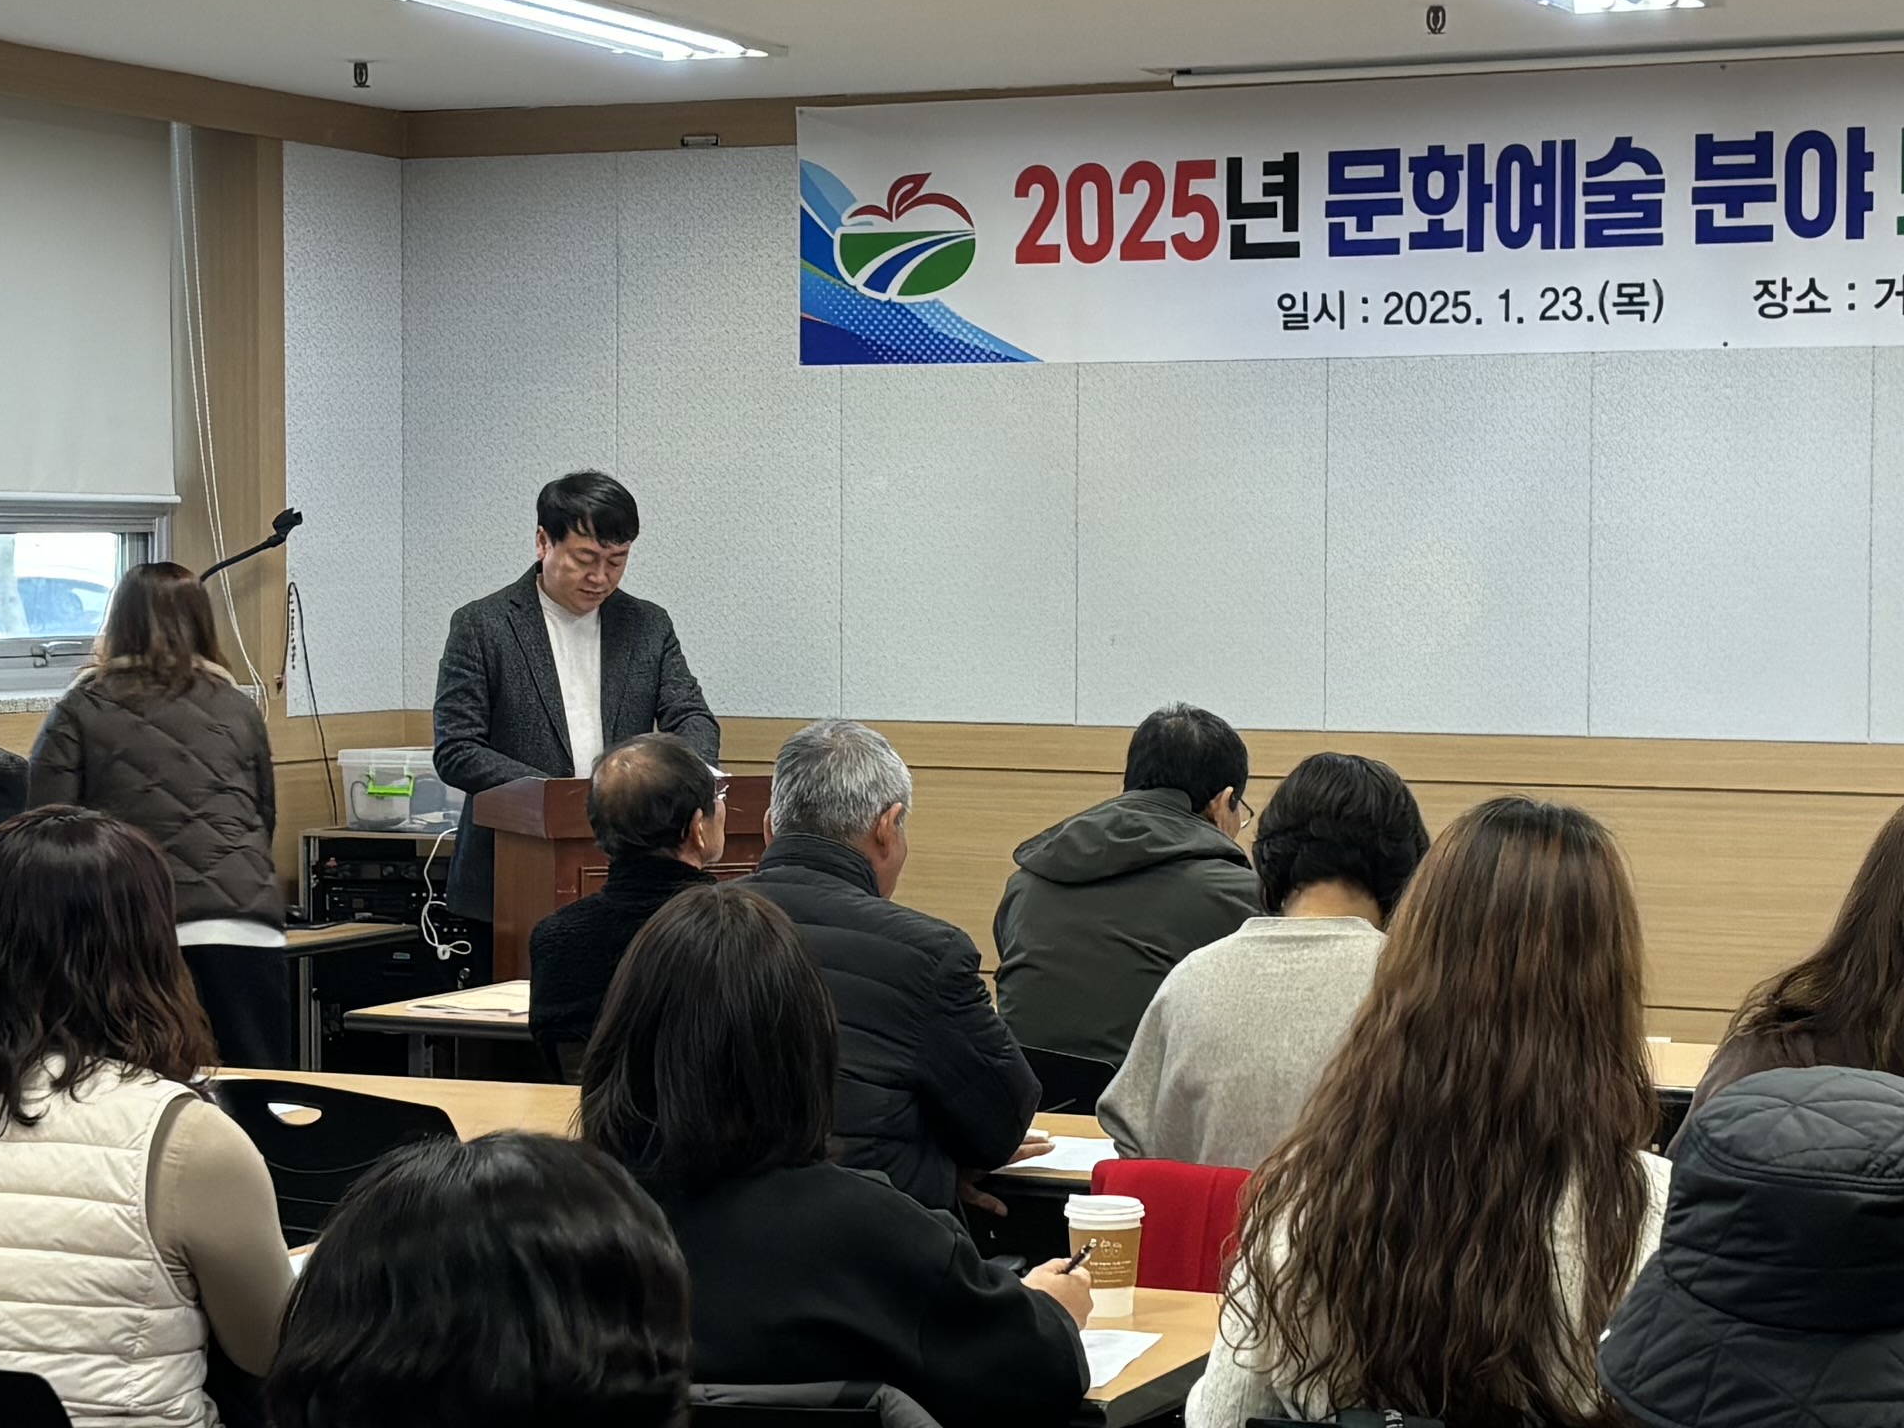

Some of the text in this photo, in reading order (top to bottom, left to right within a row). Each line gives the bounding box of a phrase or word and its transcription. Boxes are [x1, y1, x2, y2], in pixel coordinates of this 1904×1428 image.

[1013, 151, 1301, 266] 2025년
[1323, 136, 1666, 259] 문화예술
[1691, 126, 1875, 245] 분야
[1275, 290, 1346, 331] 일시
[1382, 290, 1484, 327] 2025.
[1497, 288, 1524, 325] 1.
[1538, 278, 1666, 325] 23.(목)
[1752, 276, 1833, 320] 장소
